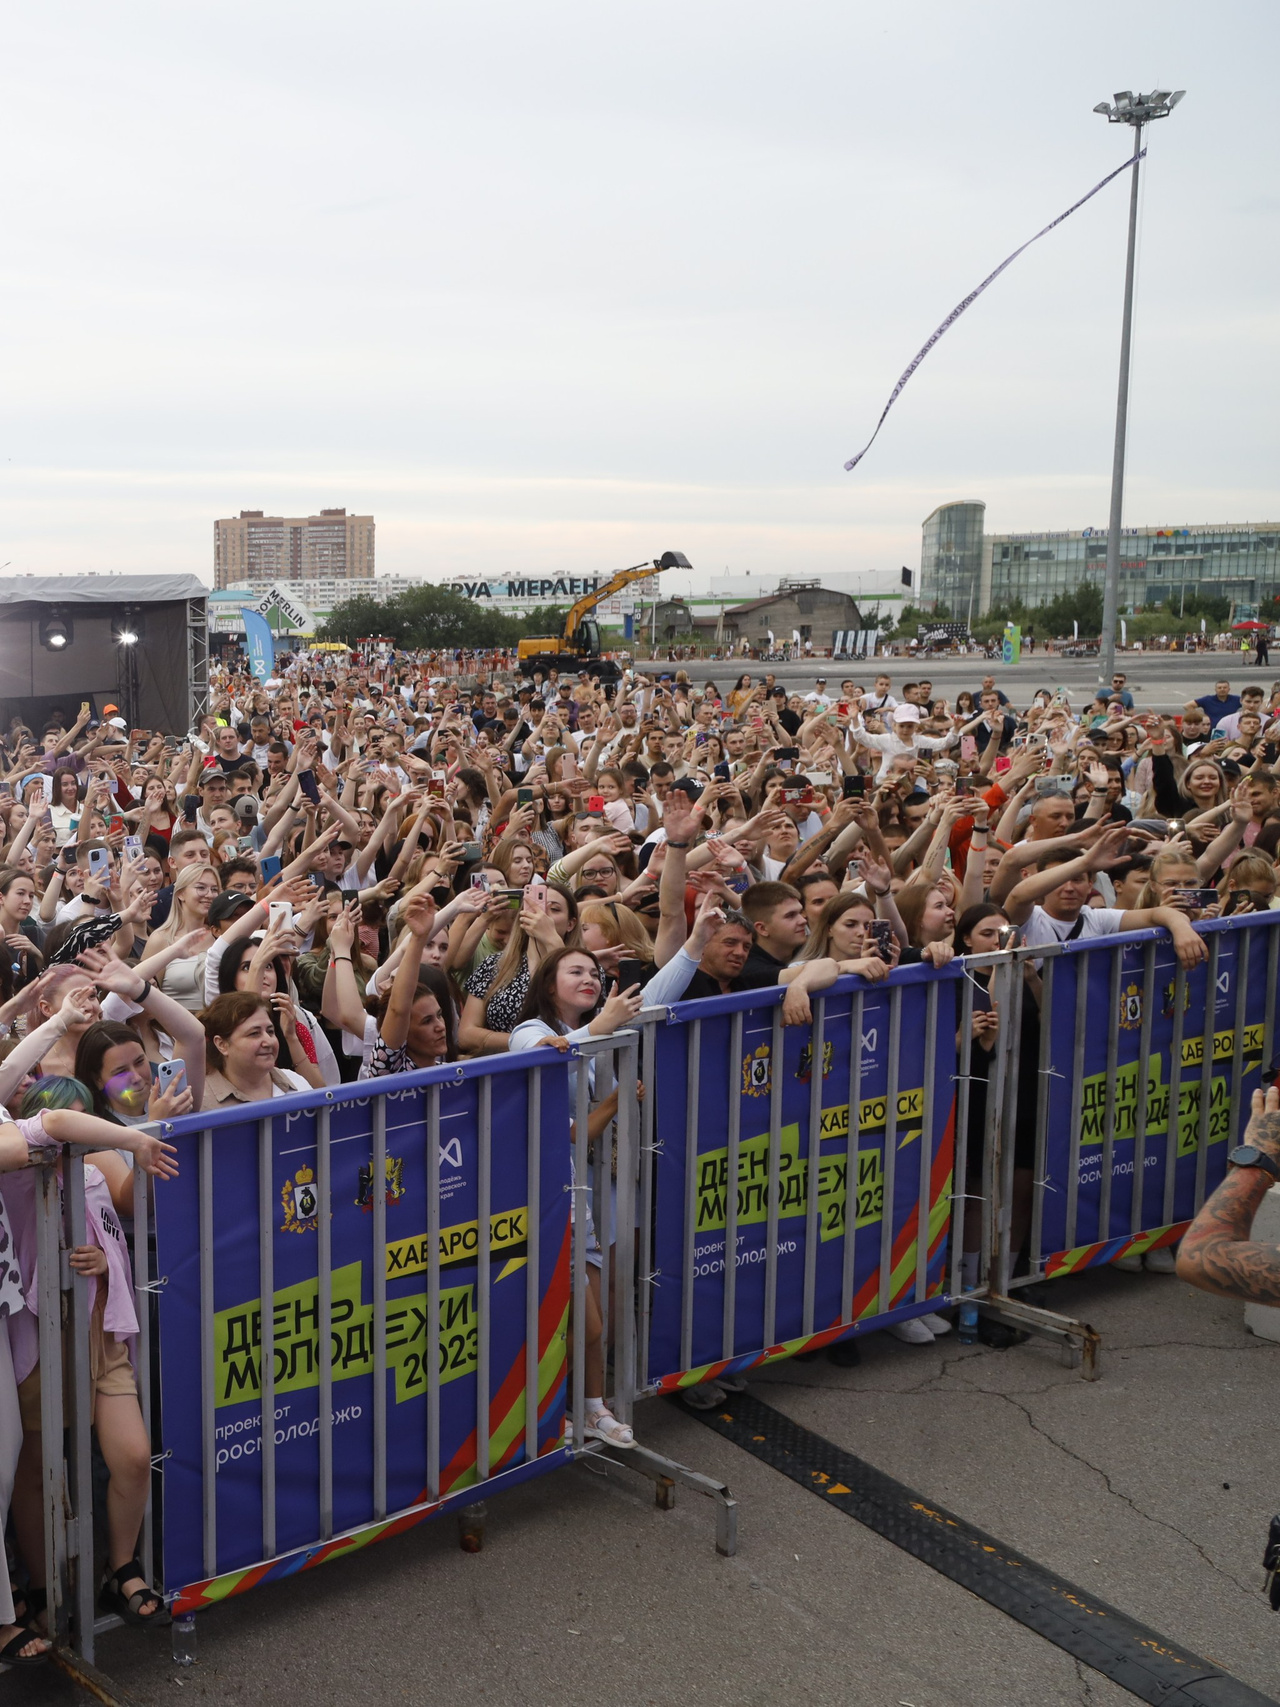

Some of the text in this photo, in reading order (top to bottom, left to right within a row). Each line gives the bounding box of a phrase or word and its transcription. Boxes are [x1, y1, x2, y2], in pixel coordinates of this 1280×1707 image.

[507, 577, 598, 598] МЕРЛЕН
[269, 589, 307, 629] MERLIN
[698, 1147, 793, 1198] ДЕНЬ
[1078, 1153, 1103, 1170] роект
[386, 1214, 524, 1273] ХАБАРОСК
[222, 1293, 355, 1364] ДЕНЬ
[215, 1405, 291, 1441] проек от
